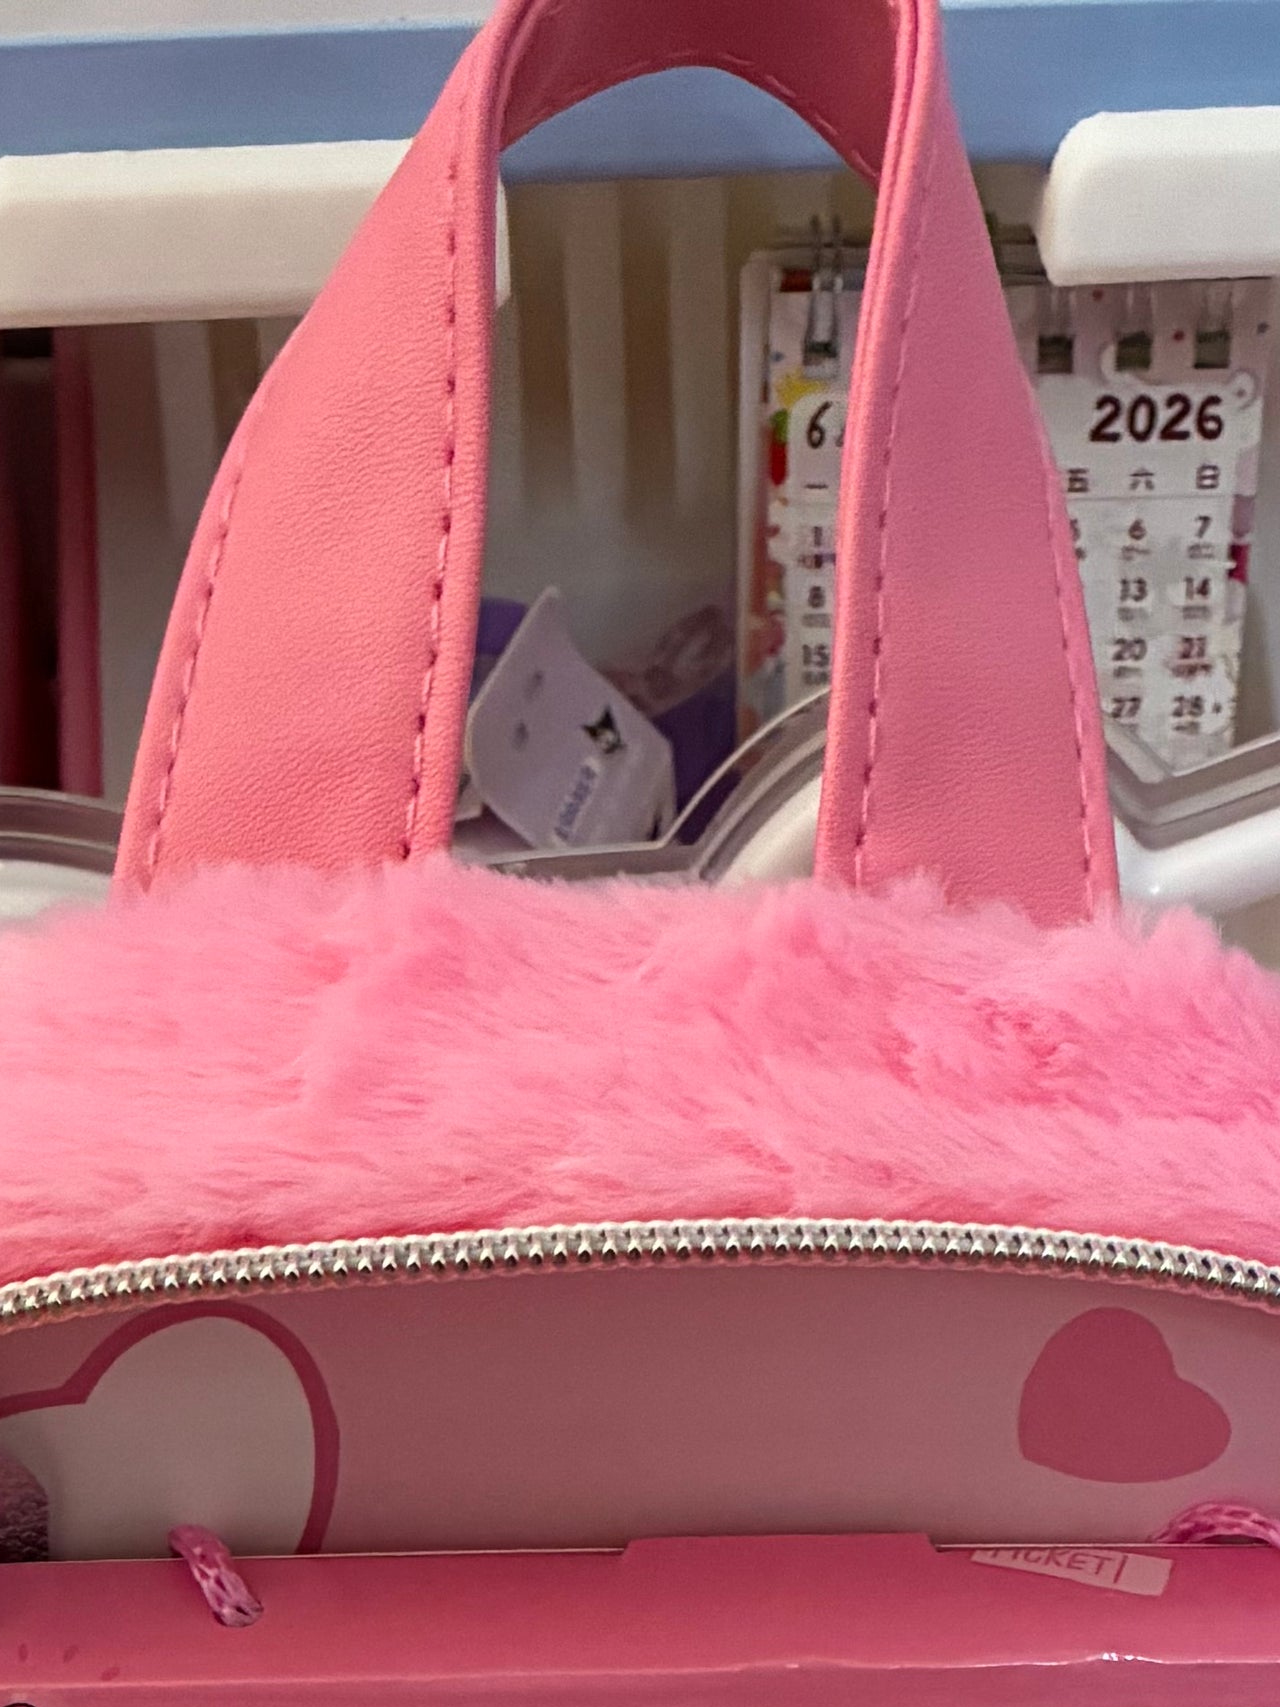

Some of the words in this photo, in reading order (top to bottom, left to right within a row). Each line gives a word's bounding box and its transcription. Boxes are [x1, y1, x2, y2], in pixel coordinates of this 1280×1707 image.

[1089, 392, 1224, 443] 2026
[1195, 515, 1213, 539] 7
[1120, 577, 1148, 602] 13
[1184, 576, 1211, 599] 14
